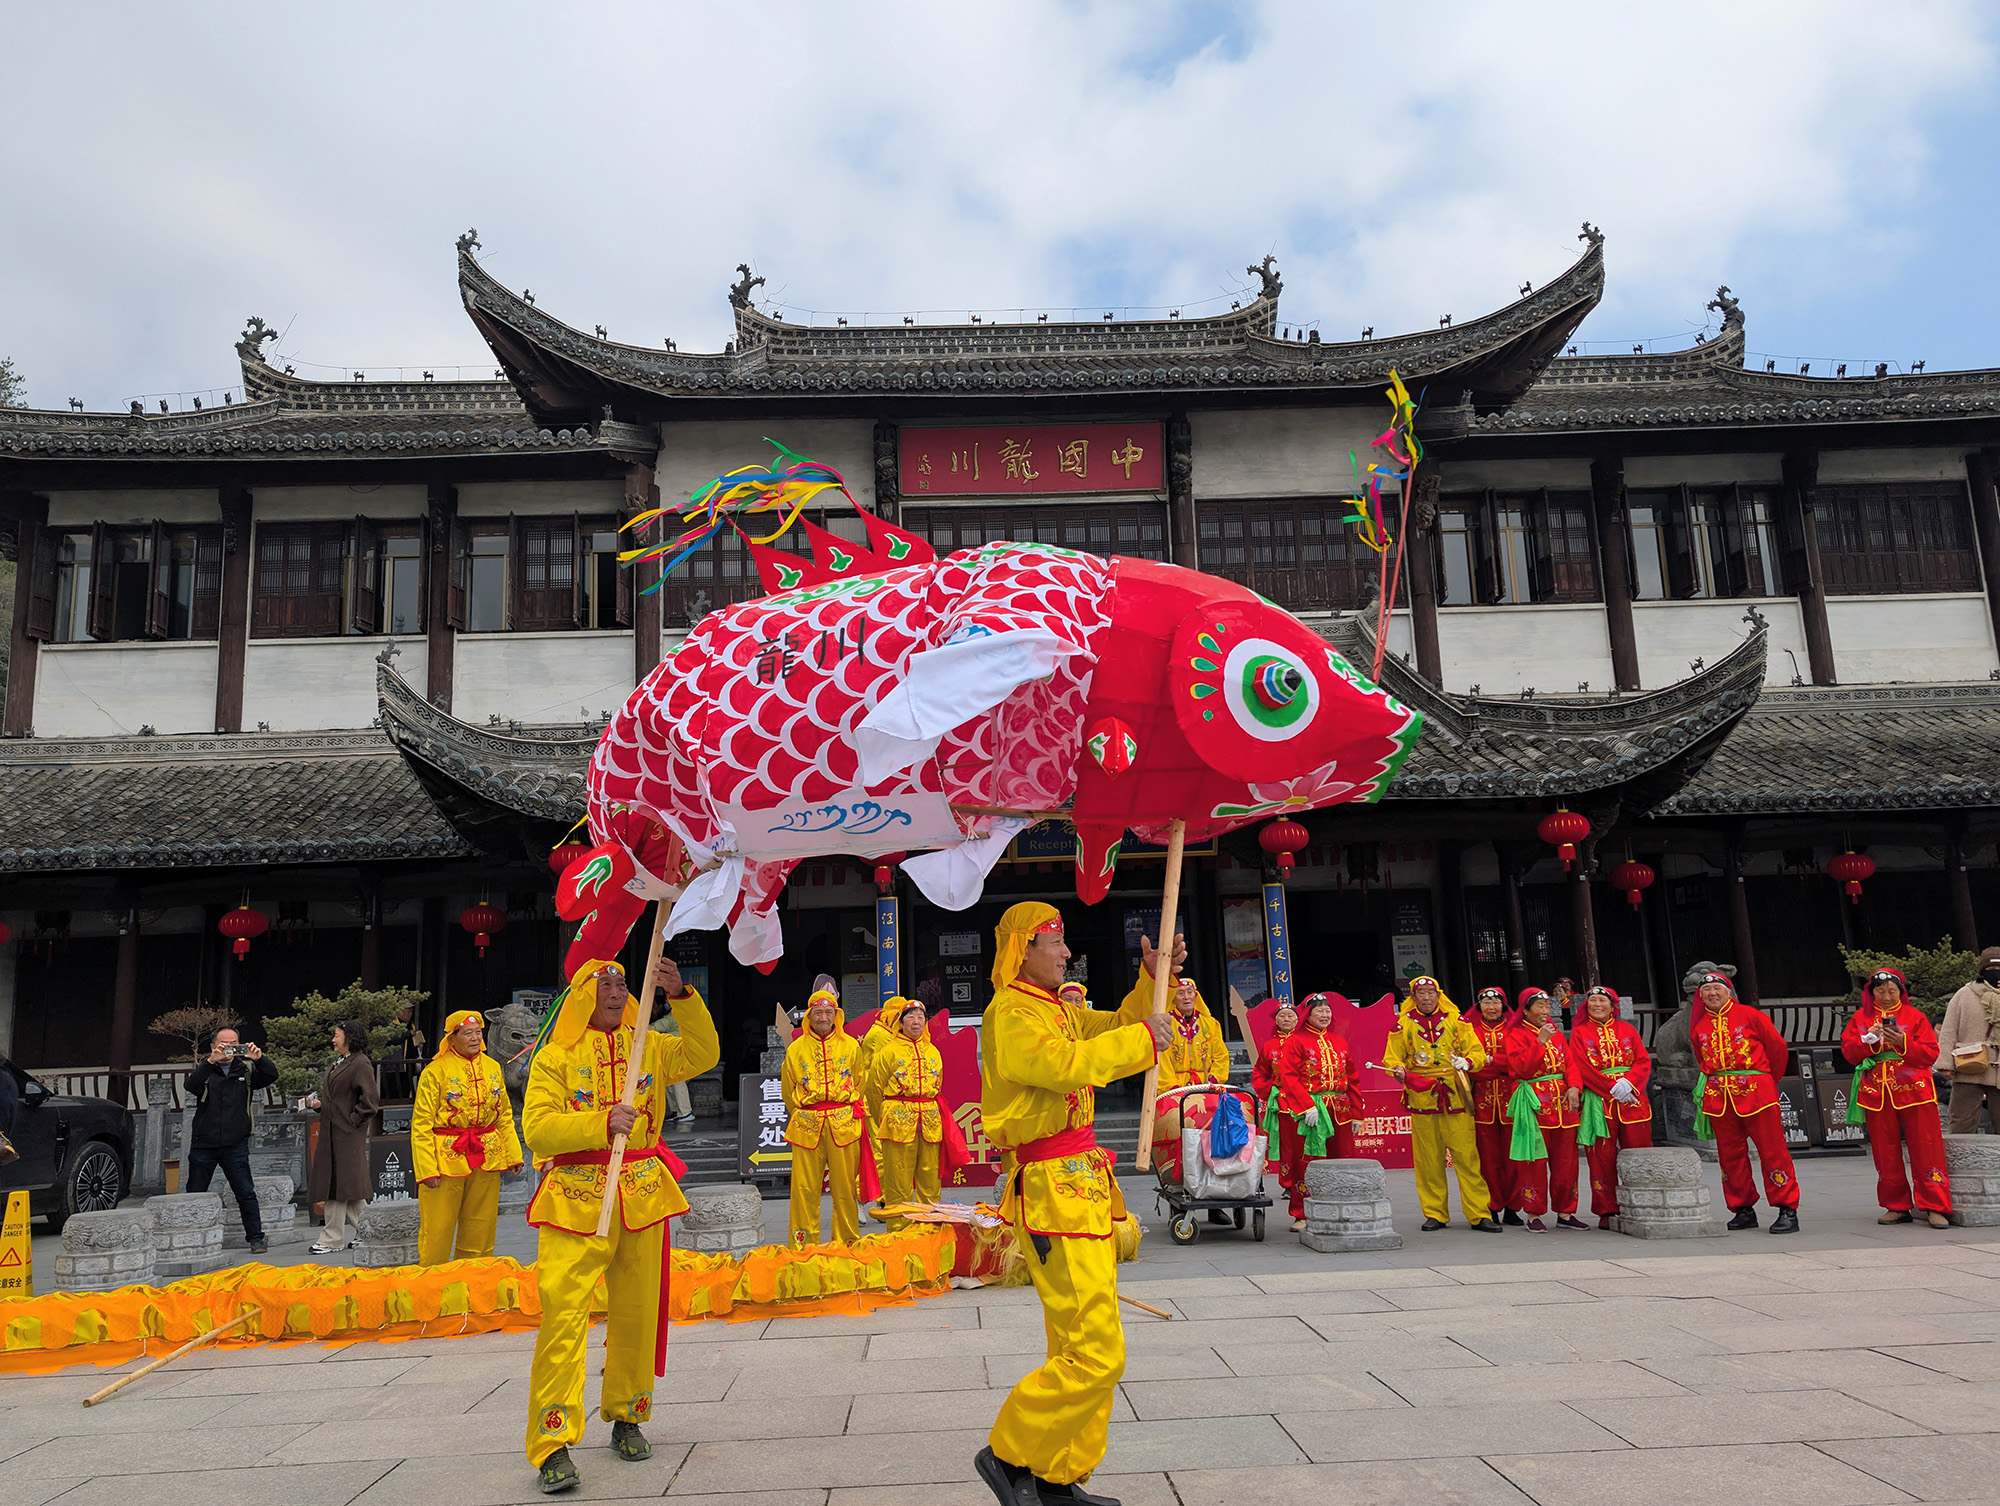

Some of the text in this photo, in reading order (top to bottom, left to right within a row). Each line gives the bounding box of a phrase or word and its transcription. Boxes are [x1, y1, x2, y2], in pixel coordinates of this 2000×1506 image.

[951, 437, 1144, 484] 中國龍川
[755, 617, 866, 686] 龍川
[945, 965, 977, 975] 景区入口
[758, 1078, 788, 1148] 售票处
[952, 1167, 967, 1185] 乐
[0, 1277, 22, 1288] 意安全
